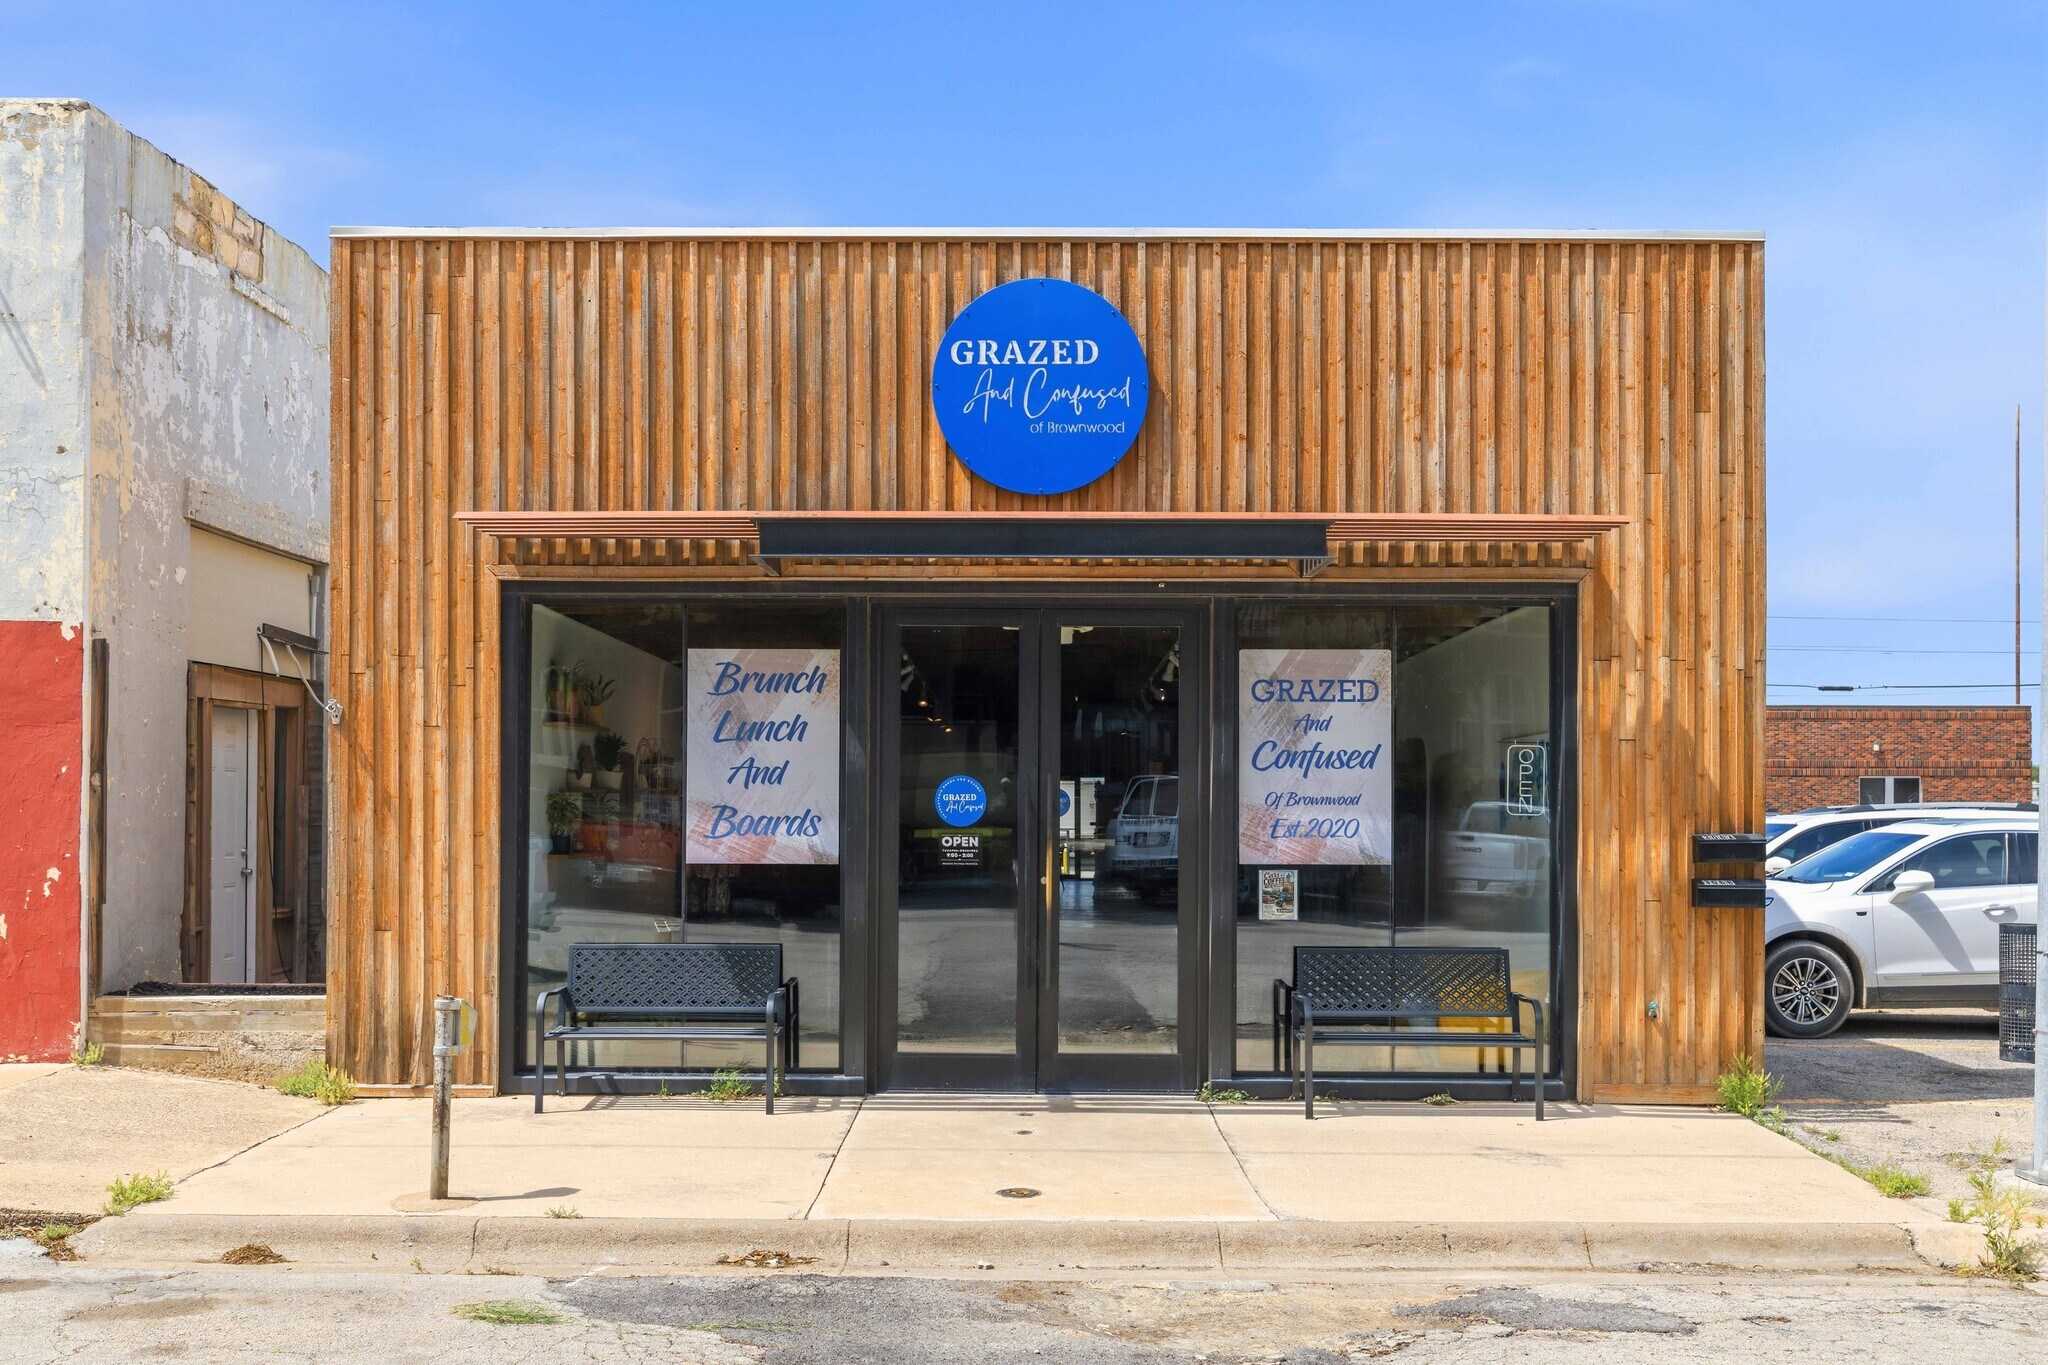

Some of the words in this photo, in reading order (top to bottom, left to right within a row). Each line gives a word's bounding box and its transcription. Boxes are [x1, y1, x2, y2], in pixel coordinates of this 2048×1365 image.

[950, 339, 1099, 365] GRAZED
[963, 368, 1015, 424] And
[1023, 367, 1131, 419] Confused
[1030, 422, 1044, 434] of
[1047, 421, 1125, 434] Brownwood
[707, 661, 827, 696] Brunch
[1251, 679, 1380, 703] GRAZED
[713, 709, 809, 743] Lunch
[1292, 713, 1334, 734] And
[727, 756, 790, 790] And
[1251, 740, 1382, 779] Confused
[1518, 748, 1535, 814] OPEN
[942, 793, 977, 801] GRAZED
[1264, 791, 1284, 809] Of
[1284, 792, 1362, 807] Brownwood
[703, 804, 822, 839] Boards
[941, 836, 979, 848] OPEN
